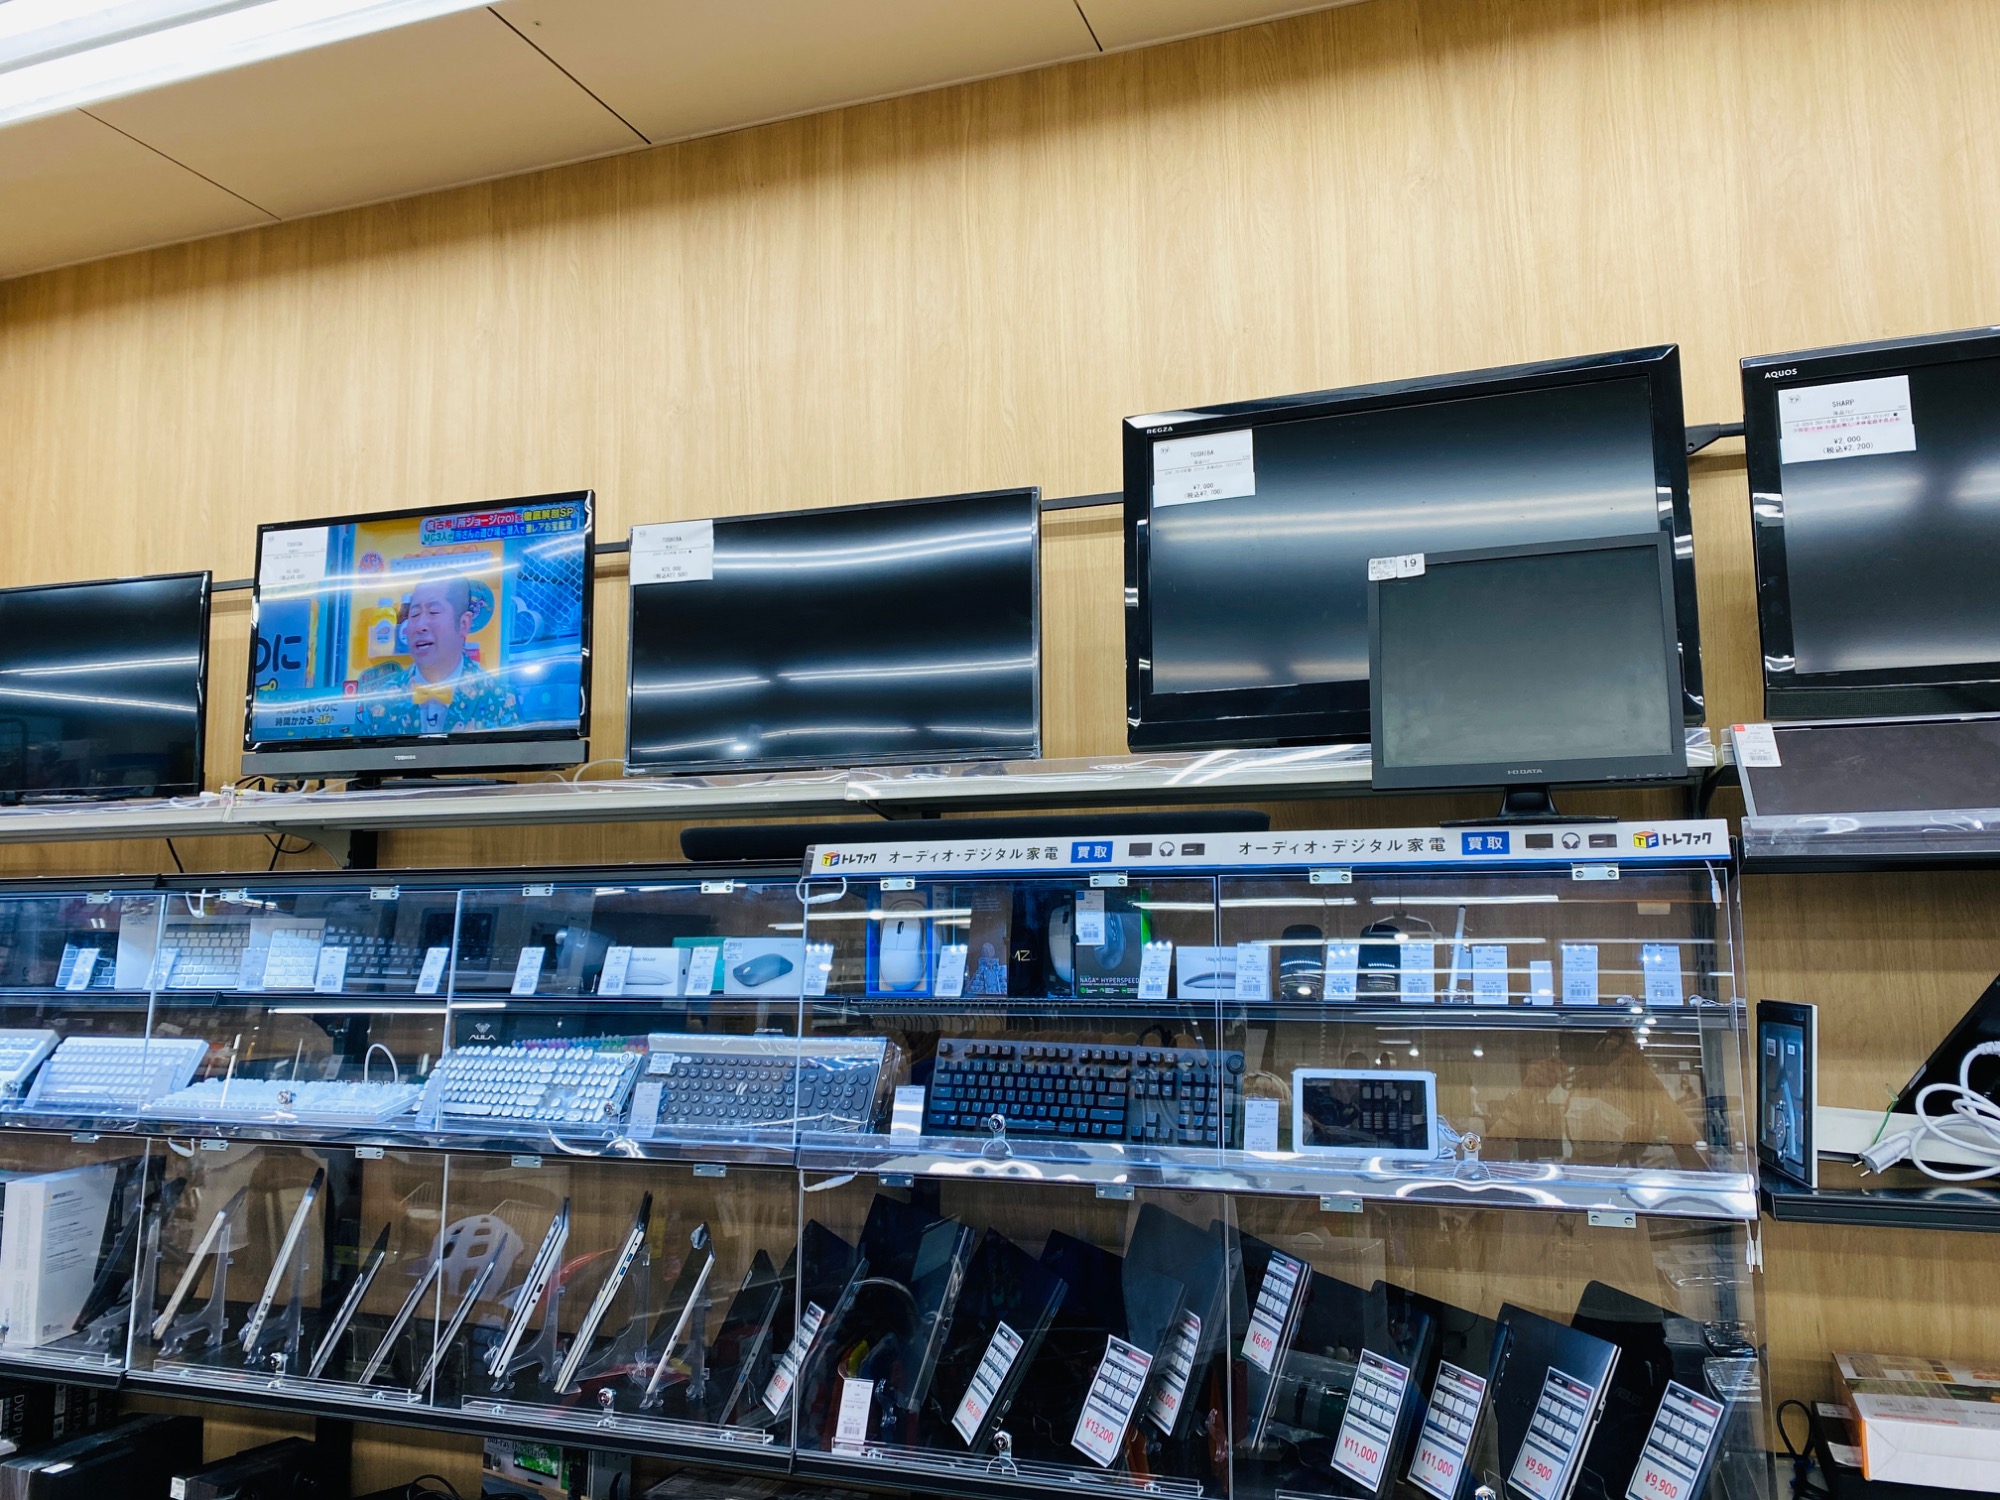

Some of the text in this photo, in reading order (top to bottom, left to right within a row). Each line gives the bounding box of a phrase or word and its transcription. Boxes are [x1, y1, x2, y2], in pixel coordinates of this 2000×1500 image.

[1764, 368, 1798, 380] AQUOS
[1832, 399, 1855, 408] SHARP
[1146, 426, 1174, 435] REGZA
[1190, 450, 1215, 458] TOSHIBA
[1403, 558, 1417, 568] 19
[393, 753, 417, 761] TOSHIBA
[1466, 835, 1505, 852] 買取
[1076, 844, 1108, 860] 買取
[1101, 977, 1140, 985] HYPERSPEED
[1252, 1330, 1273, 1352] ¥6,600
[12, 1394, 25, 1422] DVD
[1085, 1416, 1114, 1444] ¥13,200
[1344, 1435, 1378, 1464] ¥11,000
[1421, 1448, 1454, 1478] ¥11,000
[1525, 1455, 1553, 1481] ¥9,900
[1644, 1469, 1678, 1499] ¥9,900
